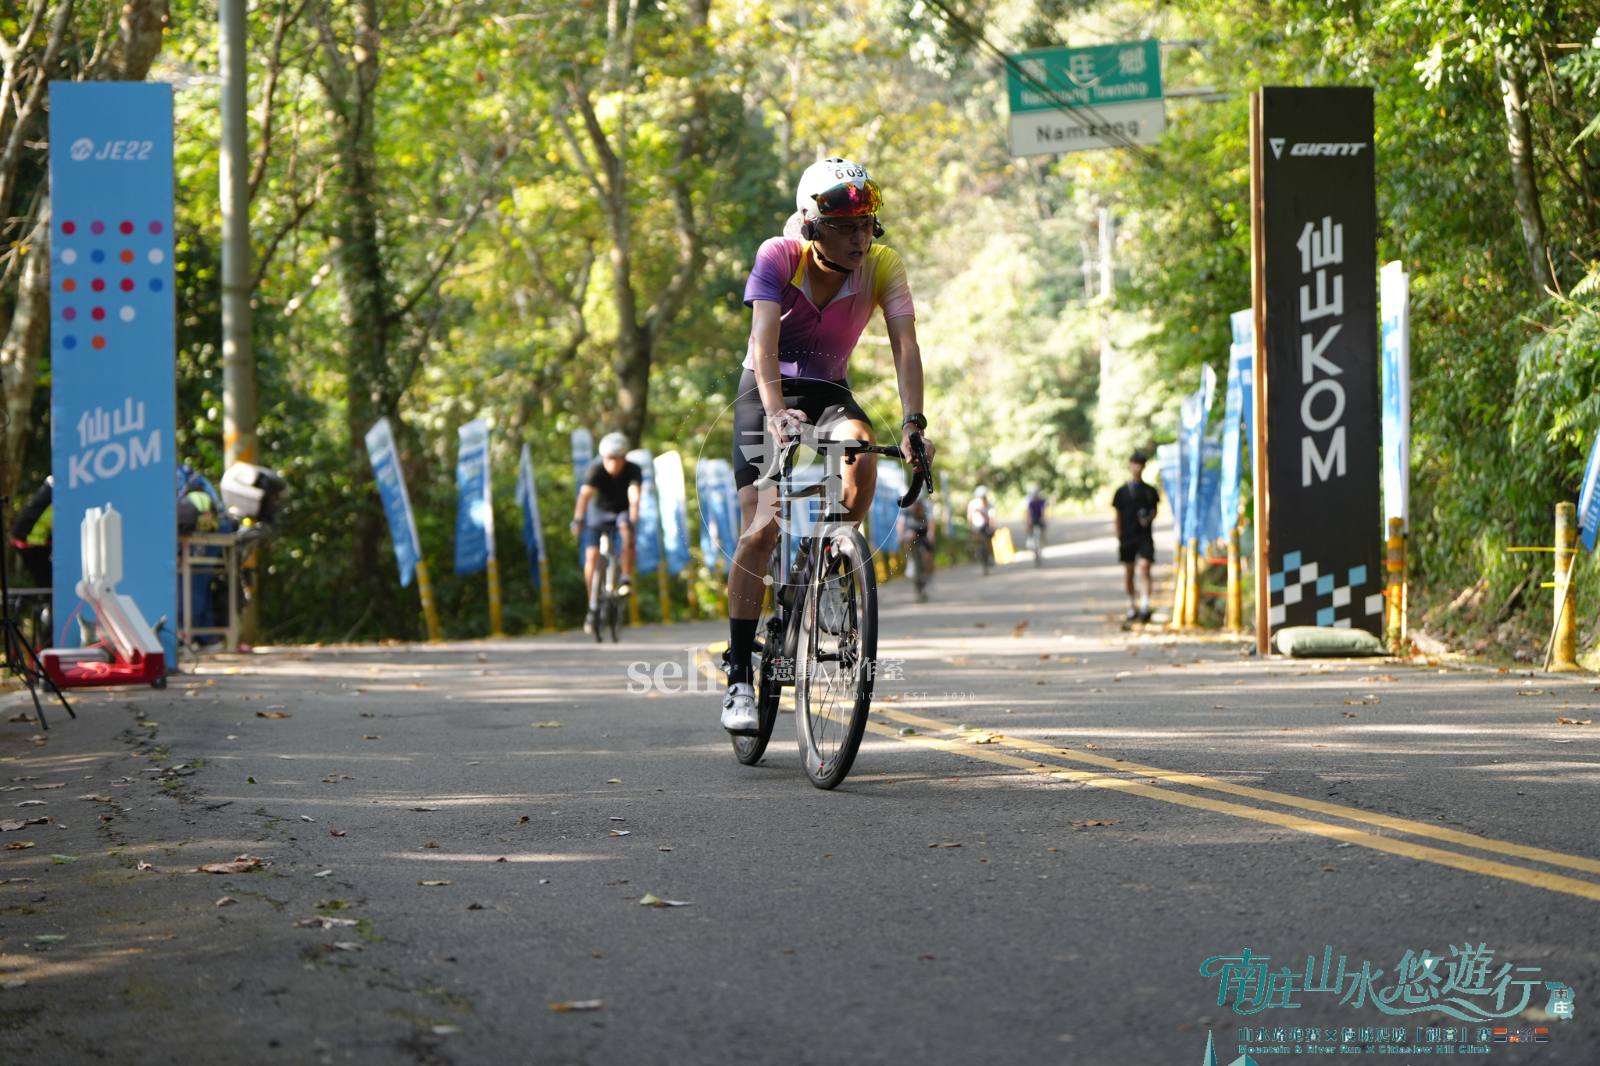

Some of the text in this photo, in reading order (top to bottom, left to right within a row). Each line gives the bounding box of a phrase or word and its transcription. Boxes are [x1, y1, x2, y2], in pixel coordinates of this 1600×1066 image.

[95, 140, 154, 161] JE22
[1290, 141, 1367, 157] GIANT
[77, 397, 146, 449] 仙山
[69, 429, 161, 488] KOM
